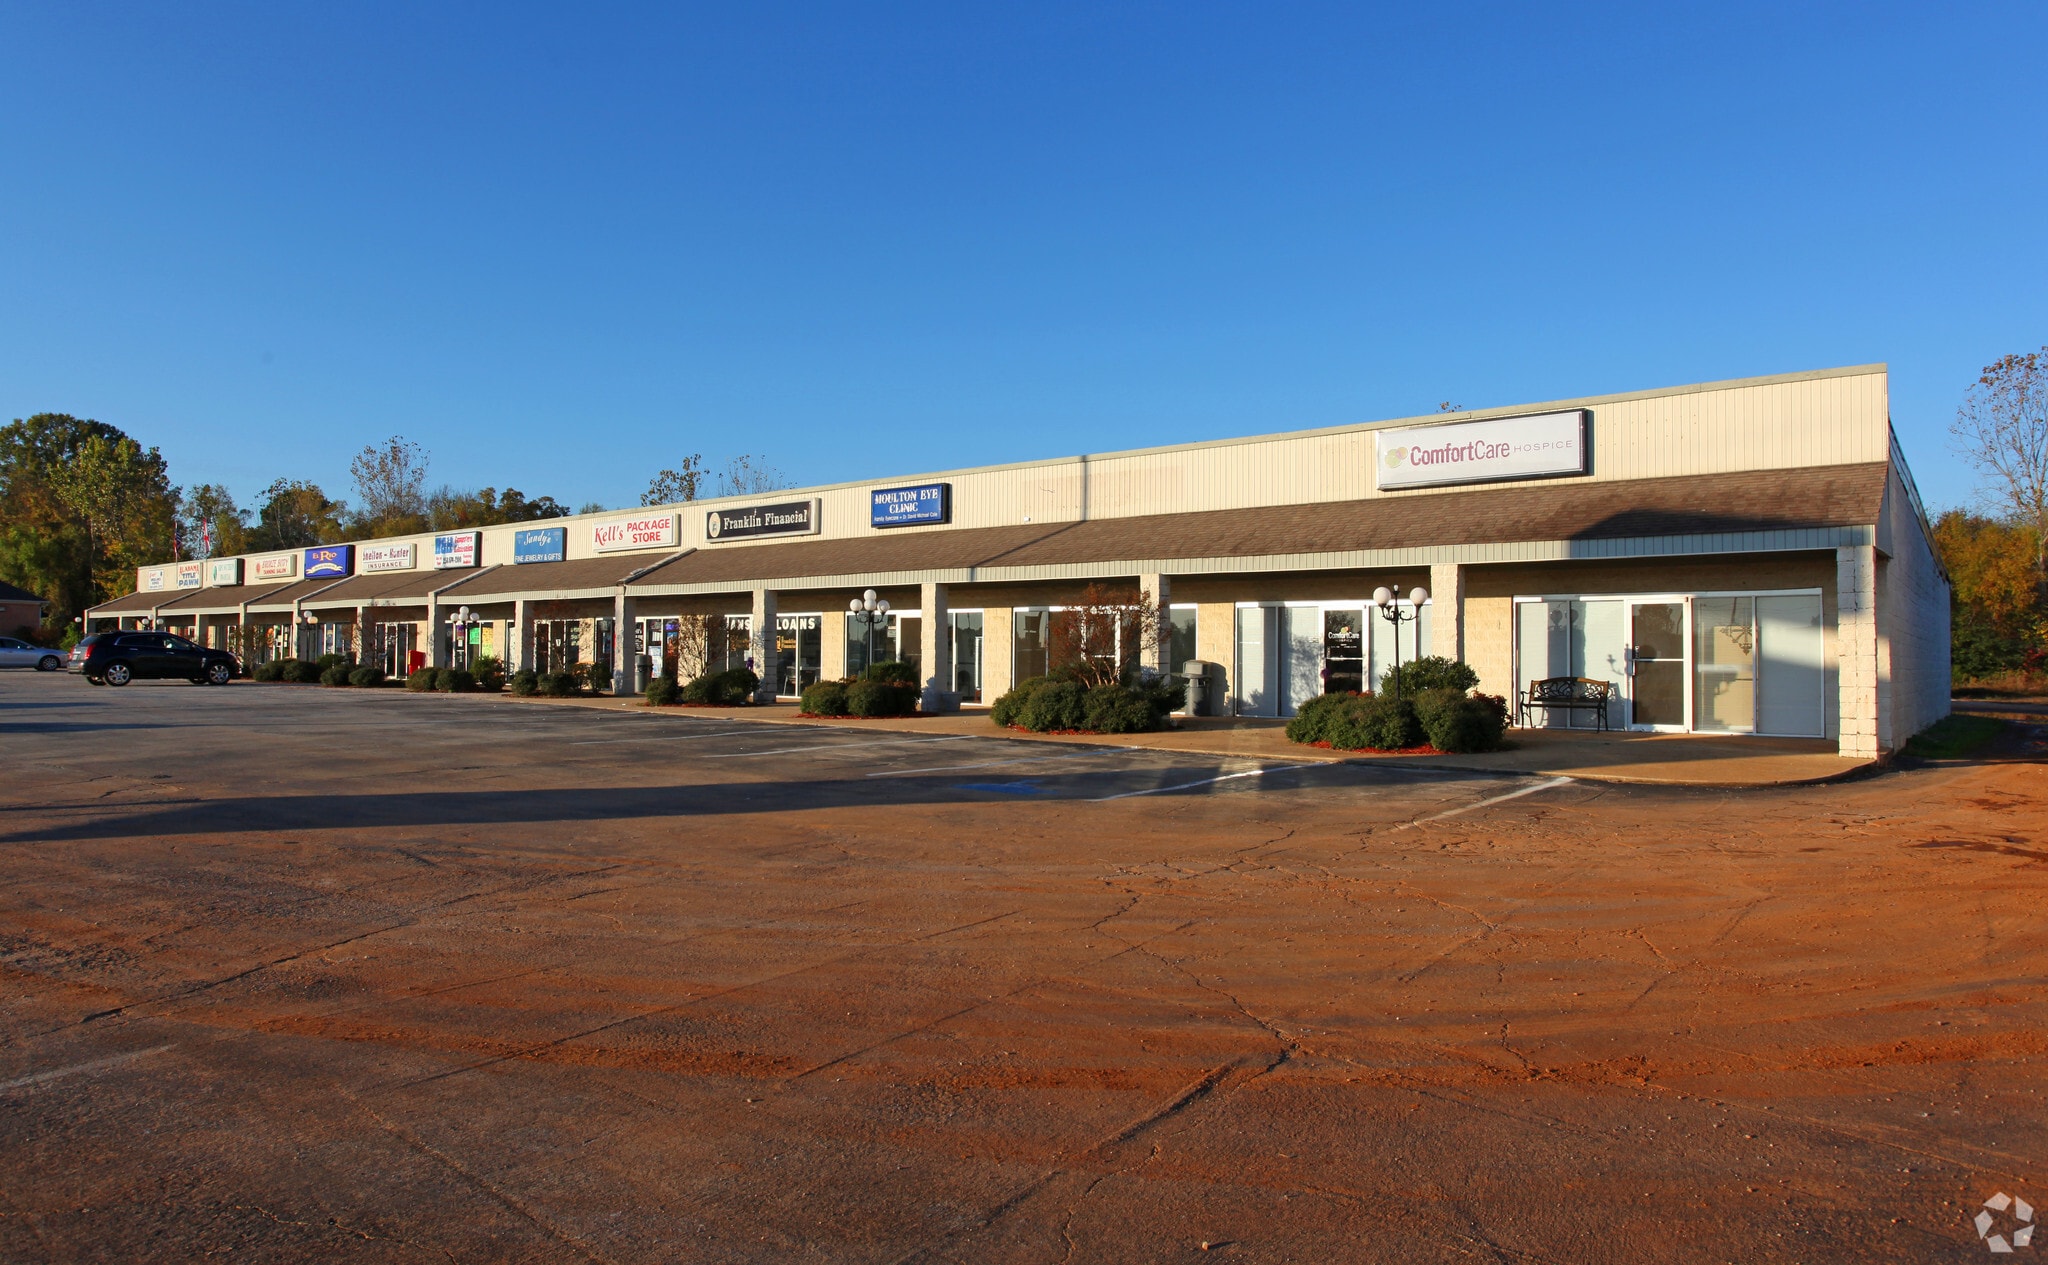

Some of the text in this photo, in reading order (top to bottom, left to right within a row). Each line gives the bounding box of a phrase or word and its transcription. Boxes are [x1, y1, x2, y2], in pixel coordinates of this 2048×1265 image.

[1410, 440, 1573, 466] ComfortCare HOSPICE
[874, 488, 938, 504] MOULTON EYE
[889, 502, 918, 514] CLINIC
[724, 509, 808, 530] Franklin Financial
[594, 518, 670, 546] Kell's PACKAGE
[632, 531, 661, 543] STORE
[367, 560, 402, 569] INSURANCE
[178, 578, 199, 587] PAWN
[776, 618, 815, 630] LOANS
